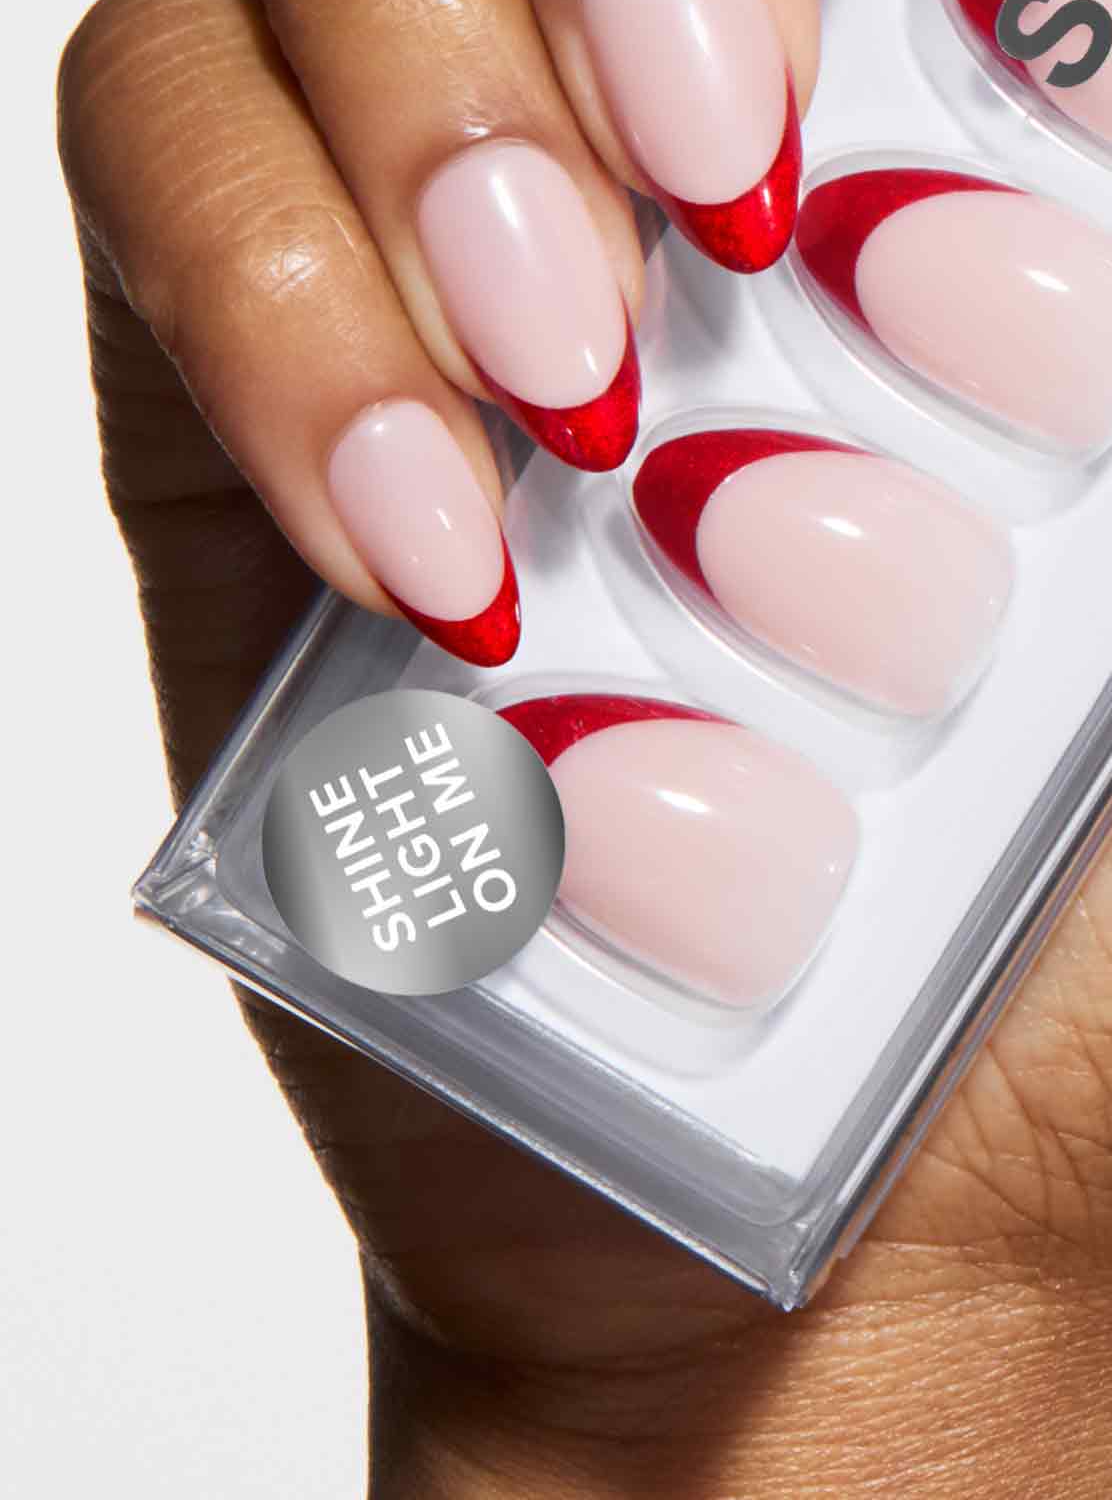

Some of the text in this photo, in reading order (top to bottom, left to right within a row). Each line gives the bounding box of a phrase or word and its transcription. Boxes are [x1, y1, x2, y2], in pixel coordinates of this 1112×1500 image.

[309, 776, 416, 952] SHINE
[358, 765, 467, 928] LIGHT
[404, 723, 516, 912] ON ME
